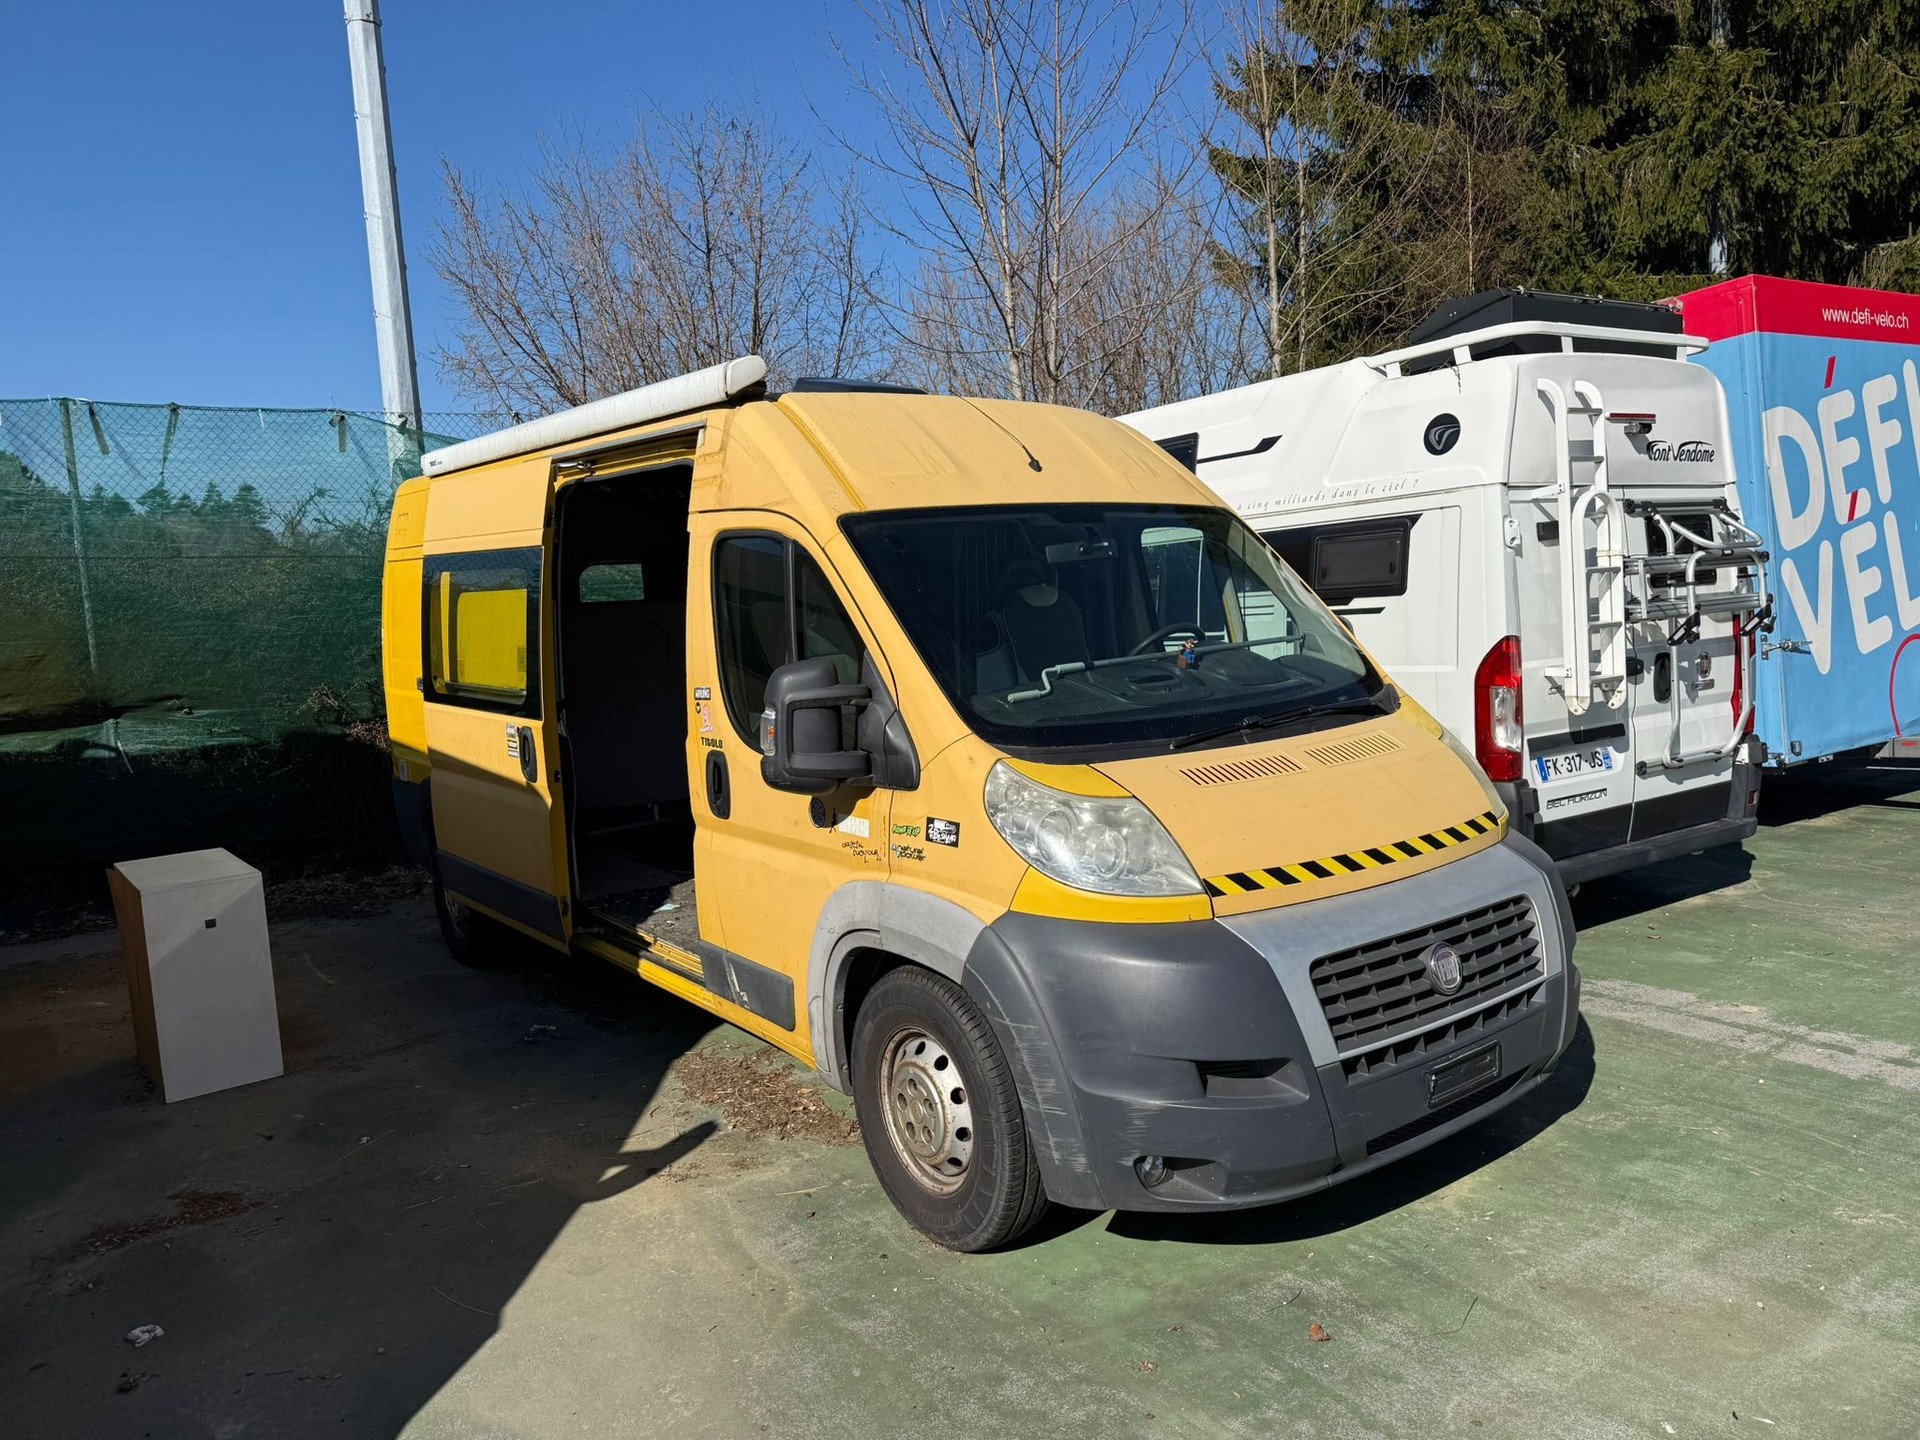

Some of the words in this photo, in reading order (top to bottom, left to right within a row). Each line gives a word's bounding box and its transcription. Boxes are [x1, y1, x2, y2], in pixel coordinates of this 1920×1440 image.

[1821, 307, 1909, 329] www.defi-velo.ch
[1247, 499, 1269, 512] cinq
[1274, 490, 1326, 505] milliards
[1331, 486, 1359, 500] dans
[1364, 482, 1377, 495] le
[1382, 478, 1408, 494] ciel
[897, 841, 924, 854] natural
[897, 851, 925, 861] power
